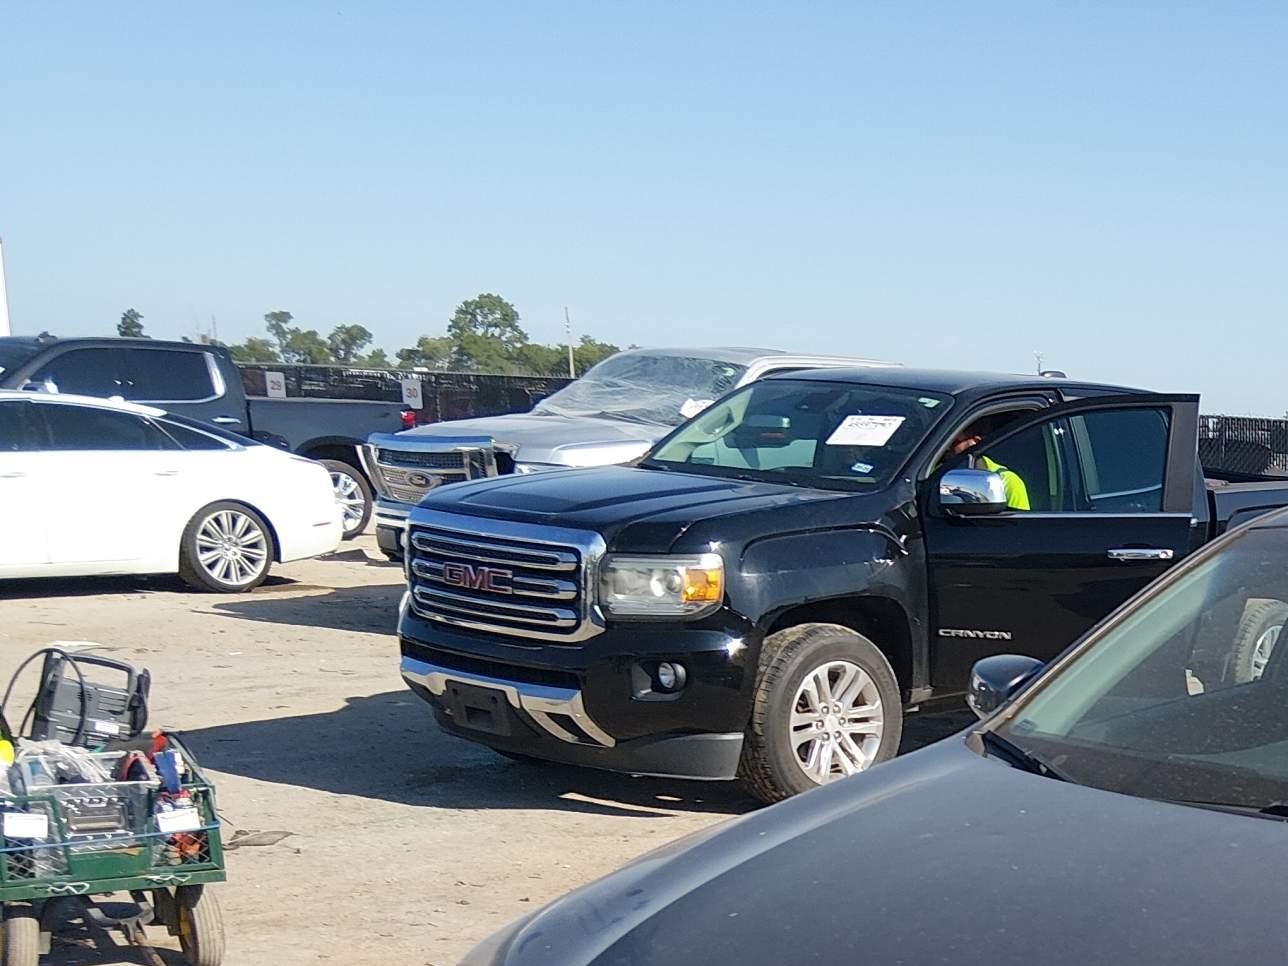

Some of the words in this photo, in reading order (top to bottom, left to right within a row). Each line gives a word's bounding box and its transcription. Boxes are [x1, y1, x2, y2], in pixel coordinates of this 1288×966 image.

[406, 387, 418, 398] 30
[443, 561, 513, 595] GMC
[938, 628, 1012, 640] CANYON
